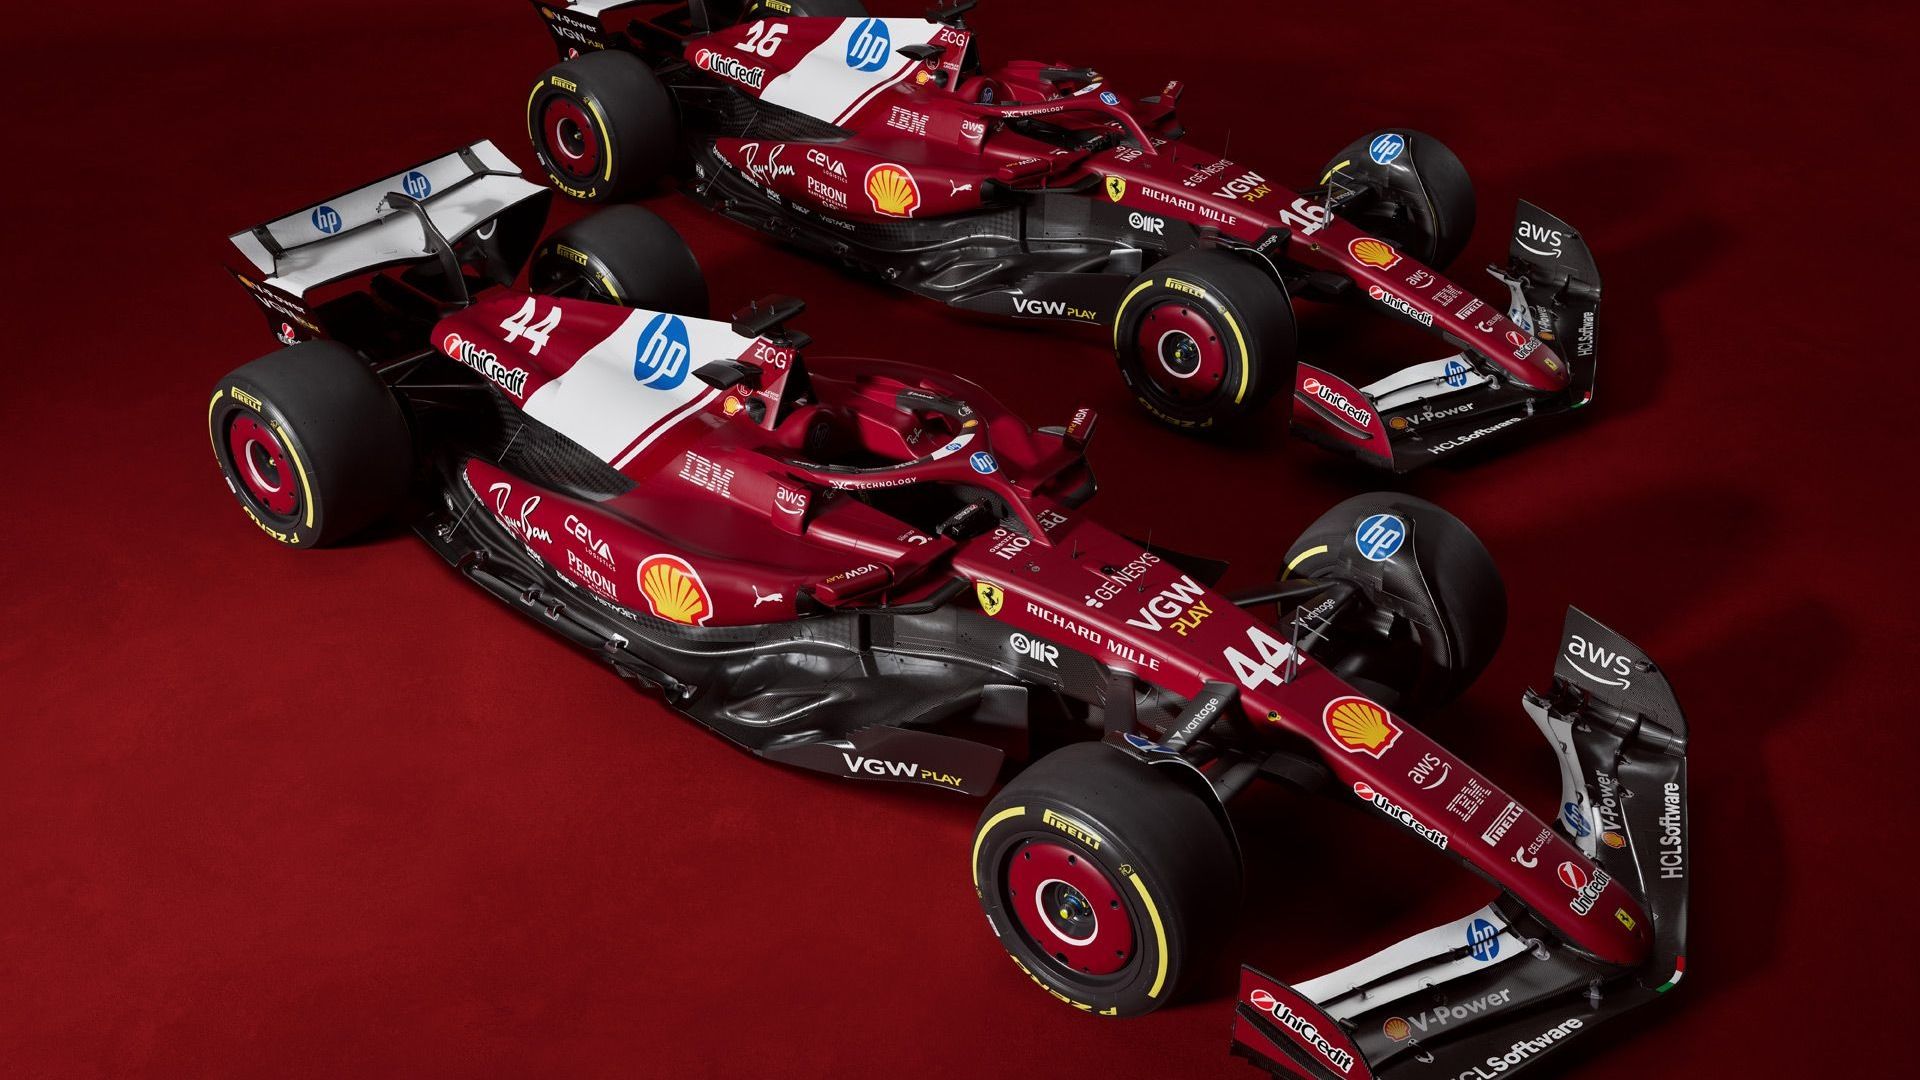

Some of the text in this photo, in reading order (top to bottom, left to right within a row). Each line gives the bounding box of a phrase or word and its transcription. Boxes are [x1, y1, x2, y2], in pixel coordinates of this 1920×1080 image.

[551, 24, 587, 43] VGW
[735, 19, 789, 58] 16
[849, 18, 889, 71] hp
[940, 28, 965, 46] ZCG
[551, 75, 577, 93] PIRELLI
[709, 52, 763, 89] UniCredit
[887, 106, 930, 136] IBM
[962, 120, 984, 133] aws
[1020, 105, 1064, 117] TECHNOLOGY
[1373, 134, 1401, 164] hp
[407, 171, 428, 200] hp
[807, 175, 847, 205] PERONI
[1212, 171, 1266, 200] VGW
[1242, 183, 1273, 203] PLAY
[316, 205, 340, 234] hp
[1141, 186, 1237, 226] RICHARD MILLE
[1279, 198, 1335, 236] 16
[1518, 220, 1562, 248] aws
[557, 243, 589, 267] PIRELLI
[1164, 277, 1207, 299] PIRELLI
[1405, 269, 1429, 286] aws
[1432, 284, 1463, 307] IBM
[1012, 296, 1097, 320] VGW PLAY
[1382, 291, 1434, 327] UniCredit
[1455, 298, 1485, 321] PIRELLI
[500, 297, 562, 356] 44
[637, 314, 688, 387] hp
[754, 341, 787, 369] ZCG
[461, 341, 529, 399] UniCredit
[1446, 360, 1468, 387] hp
[230, 386, 262, 413] PIRELLI
[1317, 384, 1372, 428] UniCredit
[1407, 401, 1475, 426] V-Power
[1427, 417, 1522, 456] HCLSoftware
[679, 450, 735, 499] IBM
[971, 451, 997, 474] hp
[777, 485, 806, 509] aws
[856, 476, 917, 490] TECHNOLOGY
[1359, 514, 1402, 562] hp
[566, 548, 617, 598] PERONI
[845, 563, 879, 580] VGW
[1095, 551, 1162, 601] GENESYS
[1125, 574, 1206, 633] VGW
[1169, 600, 1214, 637] PLAY
[1026, 602, 1161, 672] RICHARD MILLE
[1568, 634, 1632, 676] aws
[1222, 625, 1306, 691] 44
[1182, 697, 1219, 735] vantage
[842, 752, 962, 788] VGW PLAY
[1408, 752, 1441, 785] aws
[1446, 778, 1492, 822] IBM
[1596, 769, 1618, 831] V-Power
[1042, 808, 1101, 850] PIRELLI
[1374, 793, 1448, 850] UniCredit
[1481, 801, 1525, 848] PIRELLI
[1565, 802, 1591, 837] hp
[1660, 782, 1683, 879] HCLSoftware
[1528, 828, 1551, 855] CELSIUS
[1571, 868, 1611, 916] UniCredit
[1470, 918, 1498, 961] hp
[1408, 985, 1512, 1033] V-Power
[1273, 1002, 1354, 1074] UniCredit
[1450, 1018, 1583, 1080] CLSoftware
